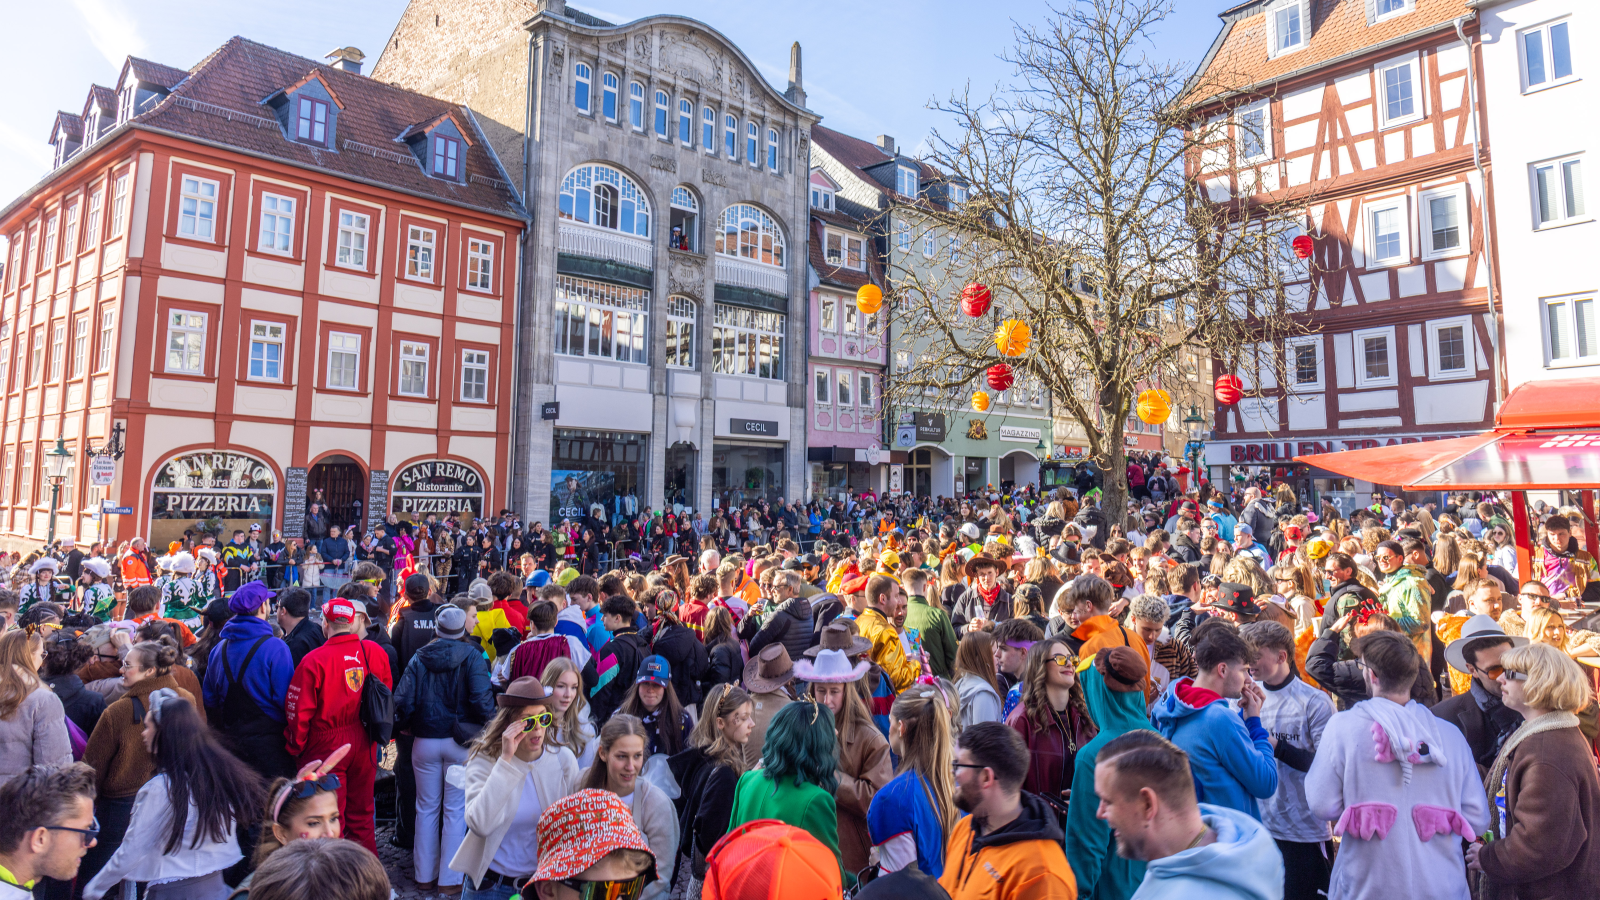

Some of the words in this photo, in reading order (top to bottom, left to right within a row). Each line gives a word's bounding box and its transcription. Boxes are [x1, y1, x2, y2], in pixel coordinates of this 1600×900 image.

[745, 422, 766, 432] CECIL
[1001, 429, 1040, 437] MAGAZZINO
[1230, 441, 1332, 462] BRILLEN
[166, 455, 206, 482] SAN
[212, 454, 265, 481] REMO
[401, 463, 432, 487] SAN
[435, 462, 477, 487] REMO
[184, 476, 247, 488] Ristorante
[416, 481, 463, 491] Ristorante
[166, 494, 261, 512] PIZZERIA
[401, 498, 473, 512] PIZZERIA
[558, 507, 586, 517] CECIL
[588, 801, 608, 811] Club
